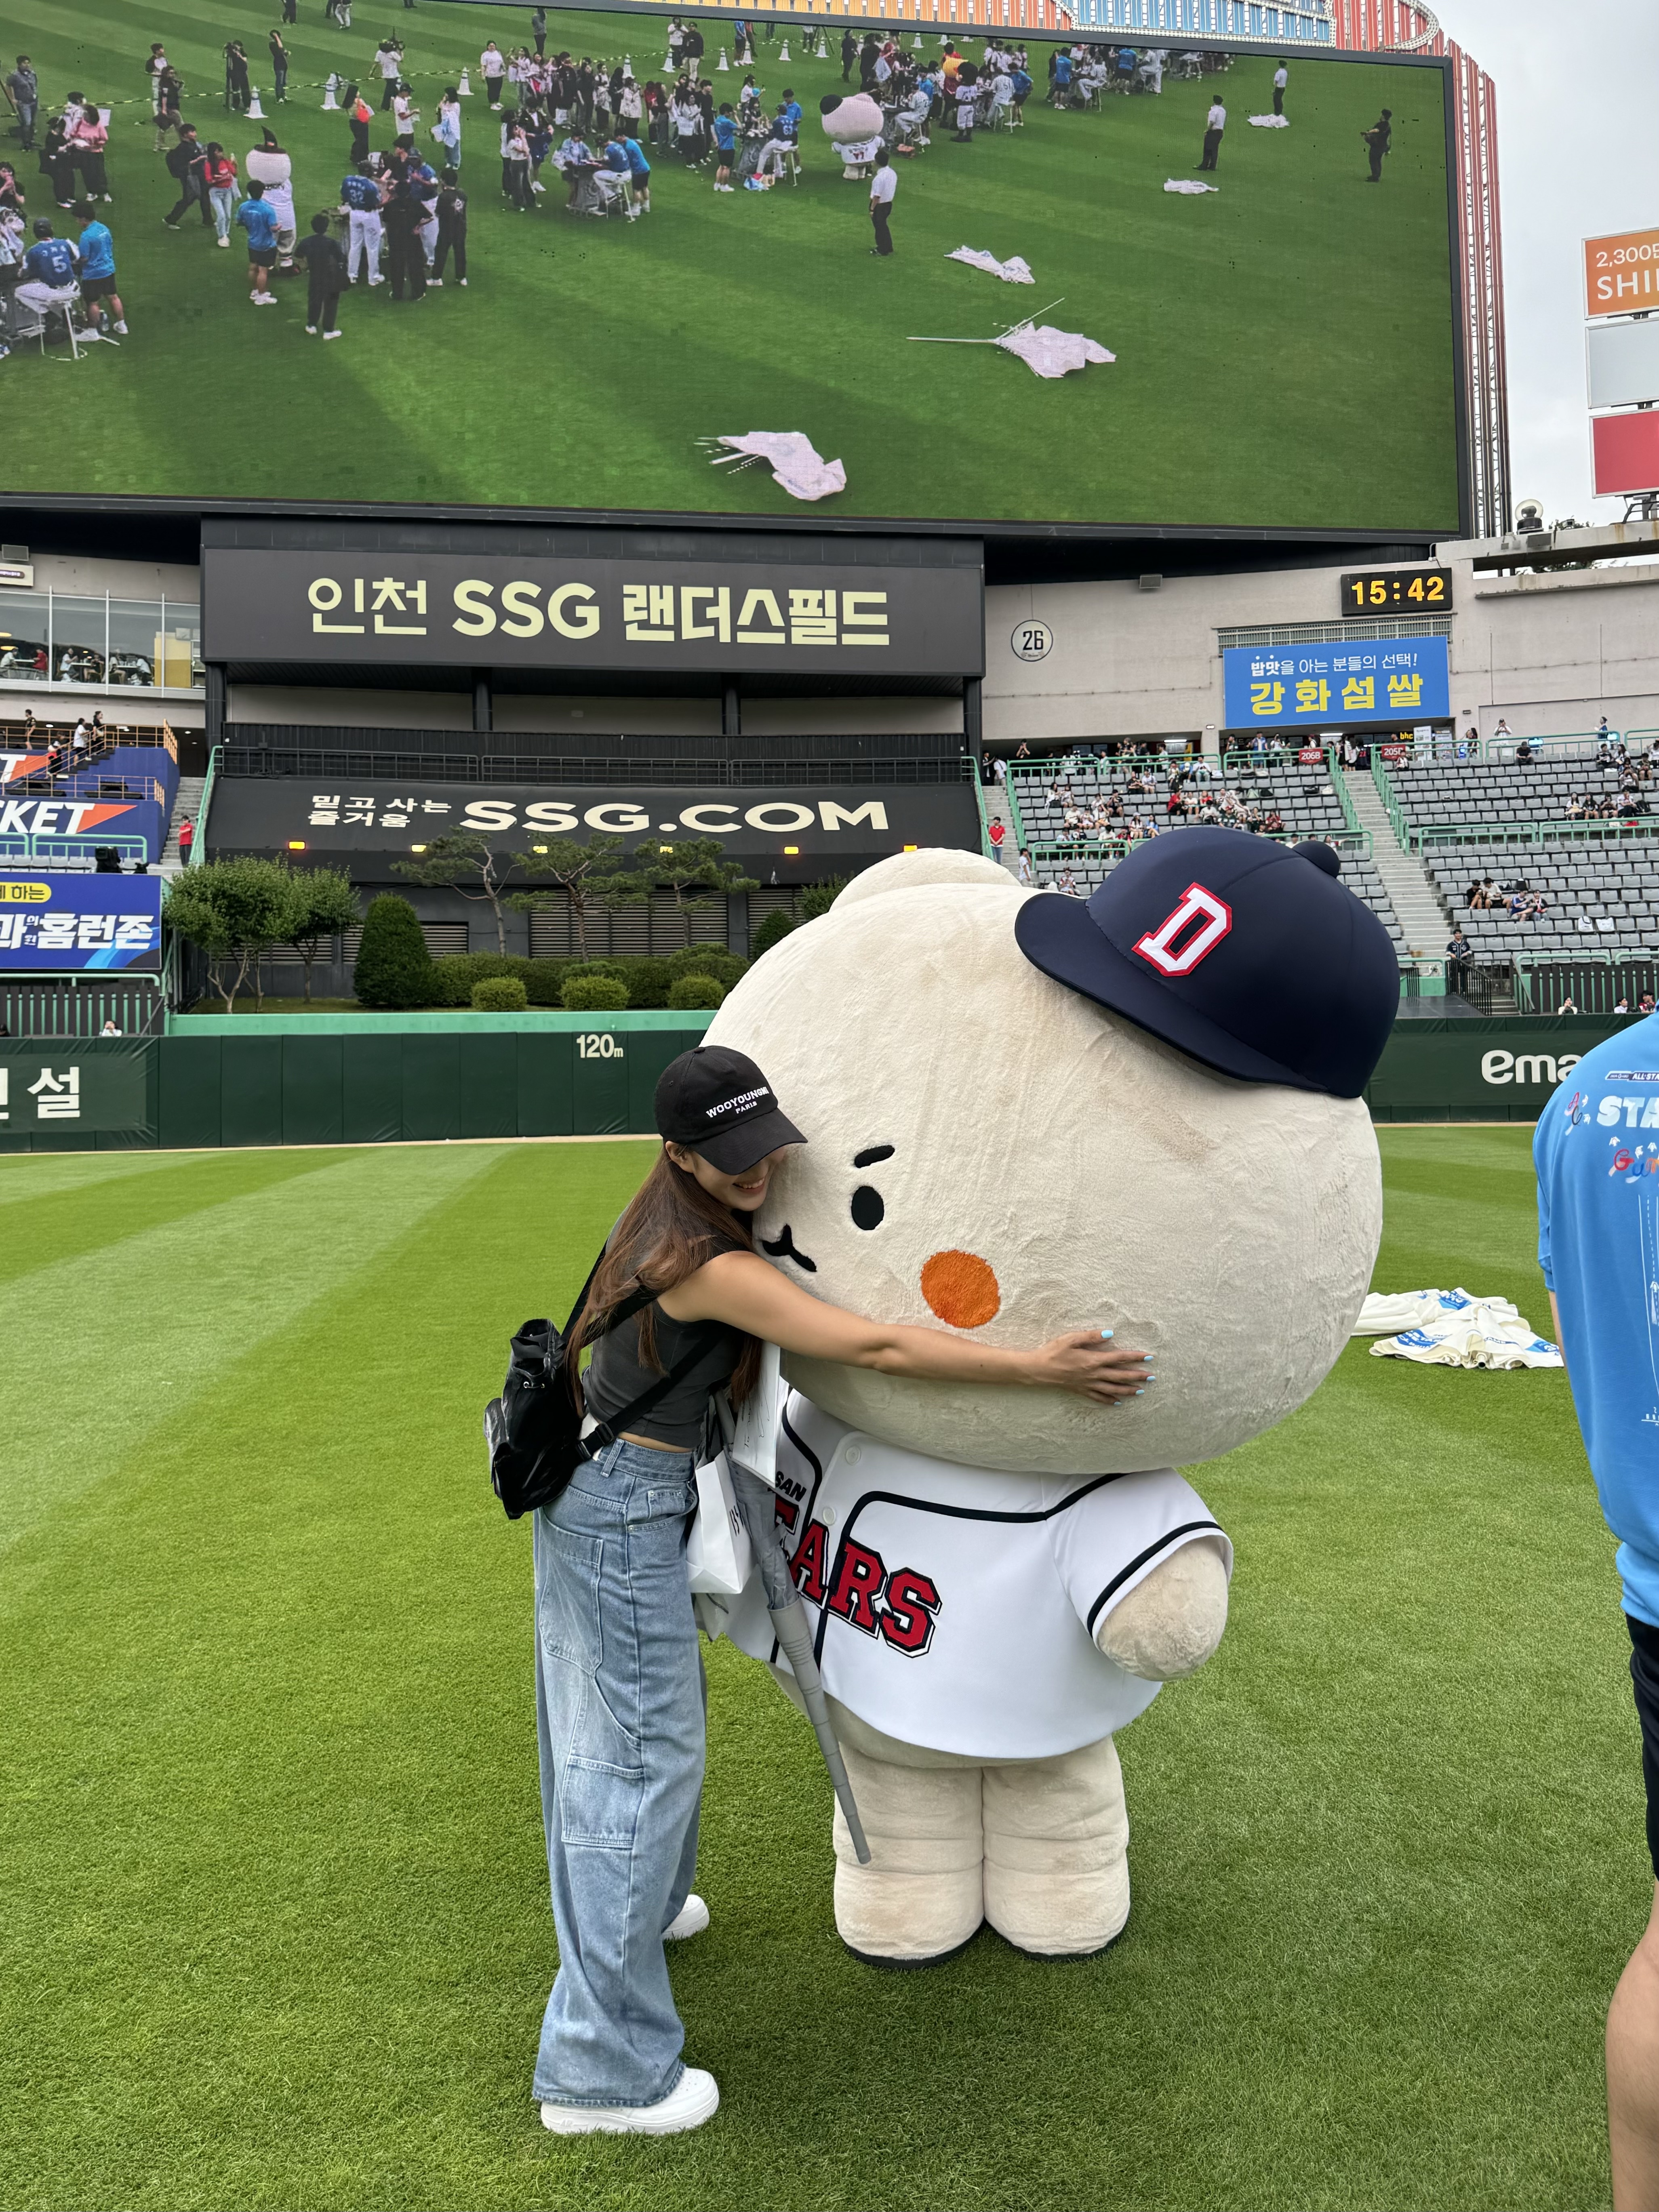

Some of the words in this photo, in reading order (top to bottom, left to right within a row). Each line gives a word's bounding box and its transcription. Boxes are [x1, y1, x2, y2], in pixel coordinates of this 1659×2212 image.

[56, 256, 67, 273] 5
[1597, 268, 1659, 300] SHI
[1351, 576, 1444, 605] 15:42
[308, 577, 427, 635] 인천
[452, 579, 600, 639] SSG
[623, 584, 889, 645] 랜더스필드
[1023, 630, 1044, 650] 26
[1251, 659, 1295, 677] 밥맛을
[1299, 658, 1328, 673] 아는
[1333, 655, 1376, 672] 분들의
[1381, 653, 1417, 669] 선택!
[1400, 732, 1413, 740] bhc
[1301, 751, 1321, 760] 206B
[312, 795, 376, 809] 믿고
[385, 798, 452, 813] 사는
[459, 800, 889, 832] SSG.COM
[0, 800, 95, 834] KET
[307, 810, 411, 828] 즐거움
[11, 885, 45, 900] 하는
[37, 913, 154, 949] 홈런존
[1132, 882, 1232, 977] D
[576, 1033, 624, 1059] 120m
[735, 1101, 758, 1114] PARIS
